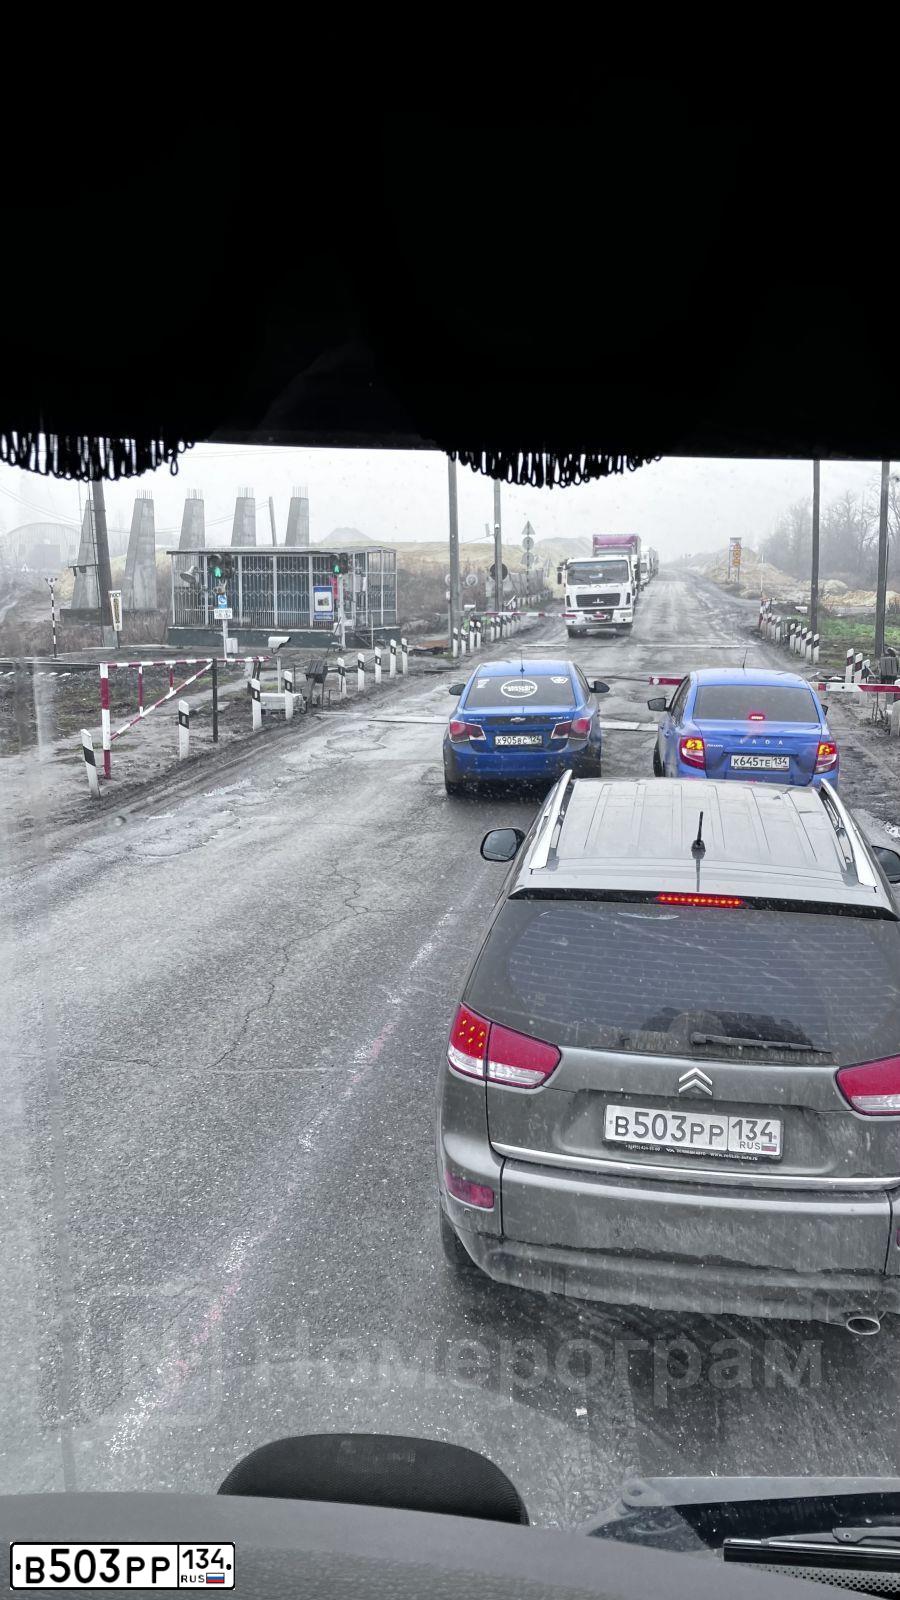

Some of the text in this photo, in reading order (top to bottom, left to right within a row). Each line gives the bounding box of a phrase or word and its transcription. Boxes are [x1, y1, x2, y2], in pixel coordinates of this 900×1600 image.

[773, 757, 787, 766] 134
[615, 1111, 773, 1145] В503РР 134
[739, 1141, 761, 1150] RUS
